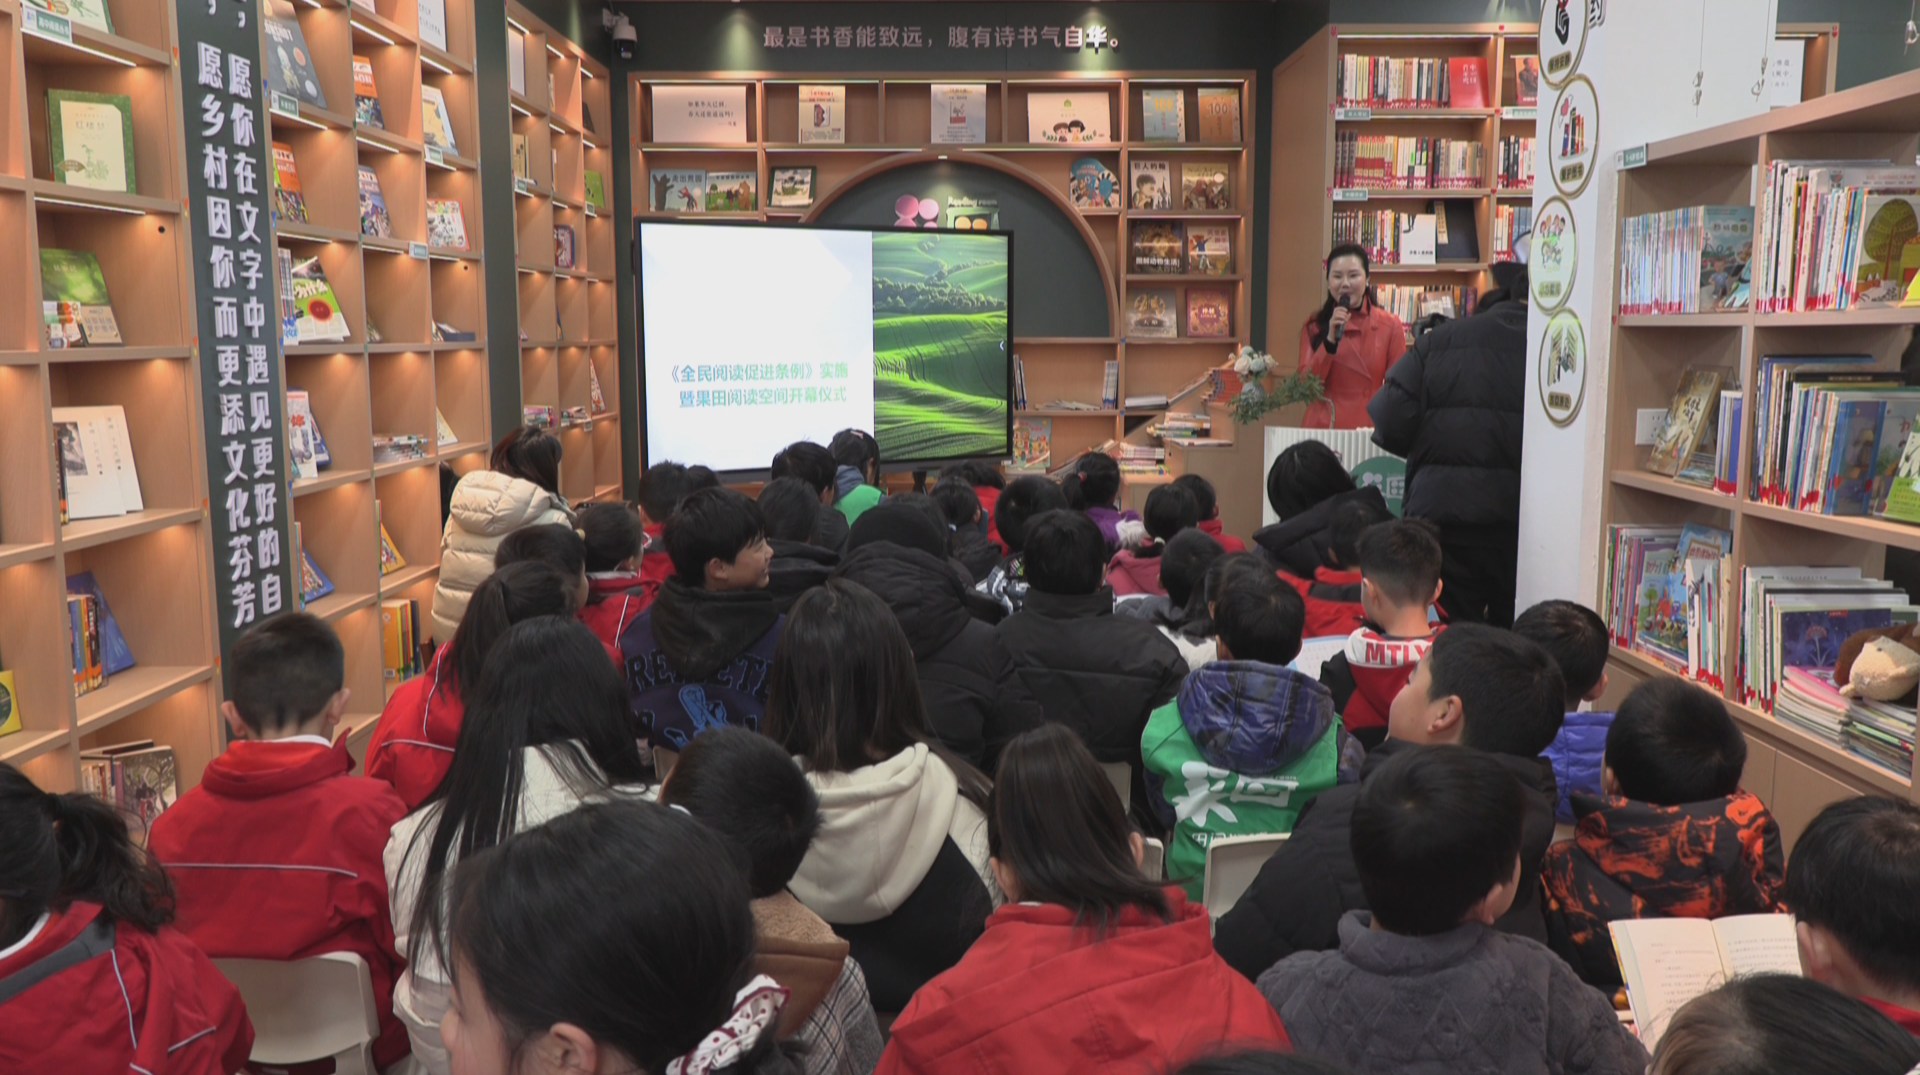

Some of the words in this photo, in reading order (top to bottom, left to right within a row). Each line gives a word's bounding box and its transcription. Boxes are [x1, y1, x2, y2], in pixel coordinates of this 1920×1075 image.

[763, 25, 1119, 50] 最是书香能致远，腹有诗书气自华。
[1208, 103, 1228, 115] 100
[671, 362, 813, 383] 《全民阅读促进条例》
[820, 361, 849, 379] 实施
[679, 386, 847, 408] 暨果田阅读空间开幕仪式
